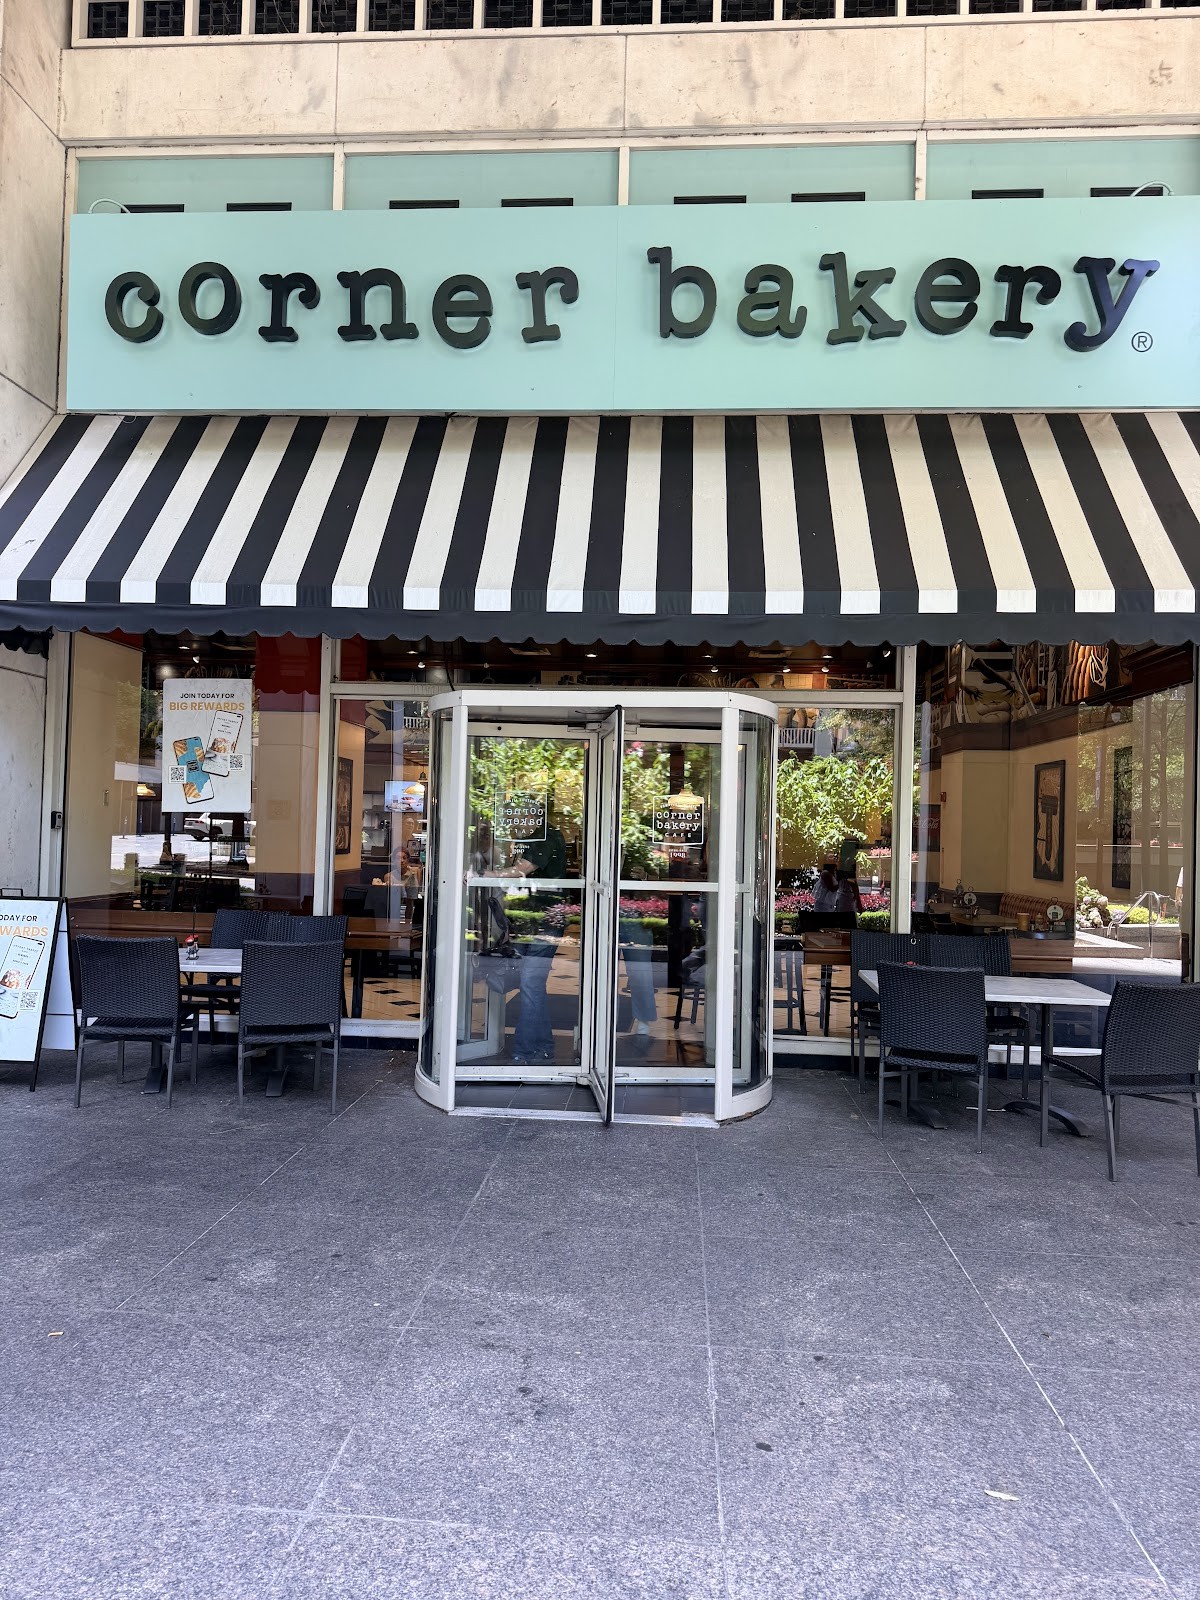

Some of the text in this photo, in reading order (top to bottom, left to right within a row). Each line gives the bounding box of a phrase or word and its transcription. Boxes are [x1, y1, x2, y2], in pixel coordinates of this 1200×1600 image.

[104, 261, 579, 350] corner
[647, 246, 1160, 353] bakery
[169, 702, 245, 711] BIG REWARDS
[656, 811, 701, 820] corner
[656, 820, 701, 831] bakery
[0, 926, 48, 937] WARDS
